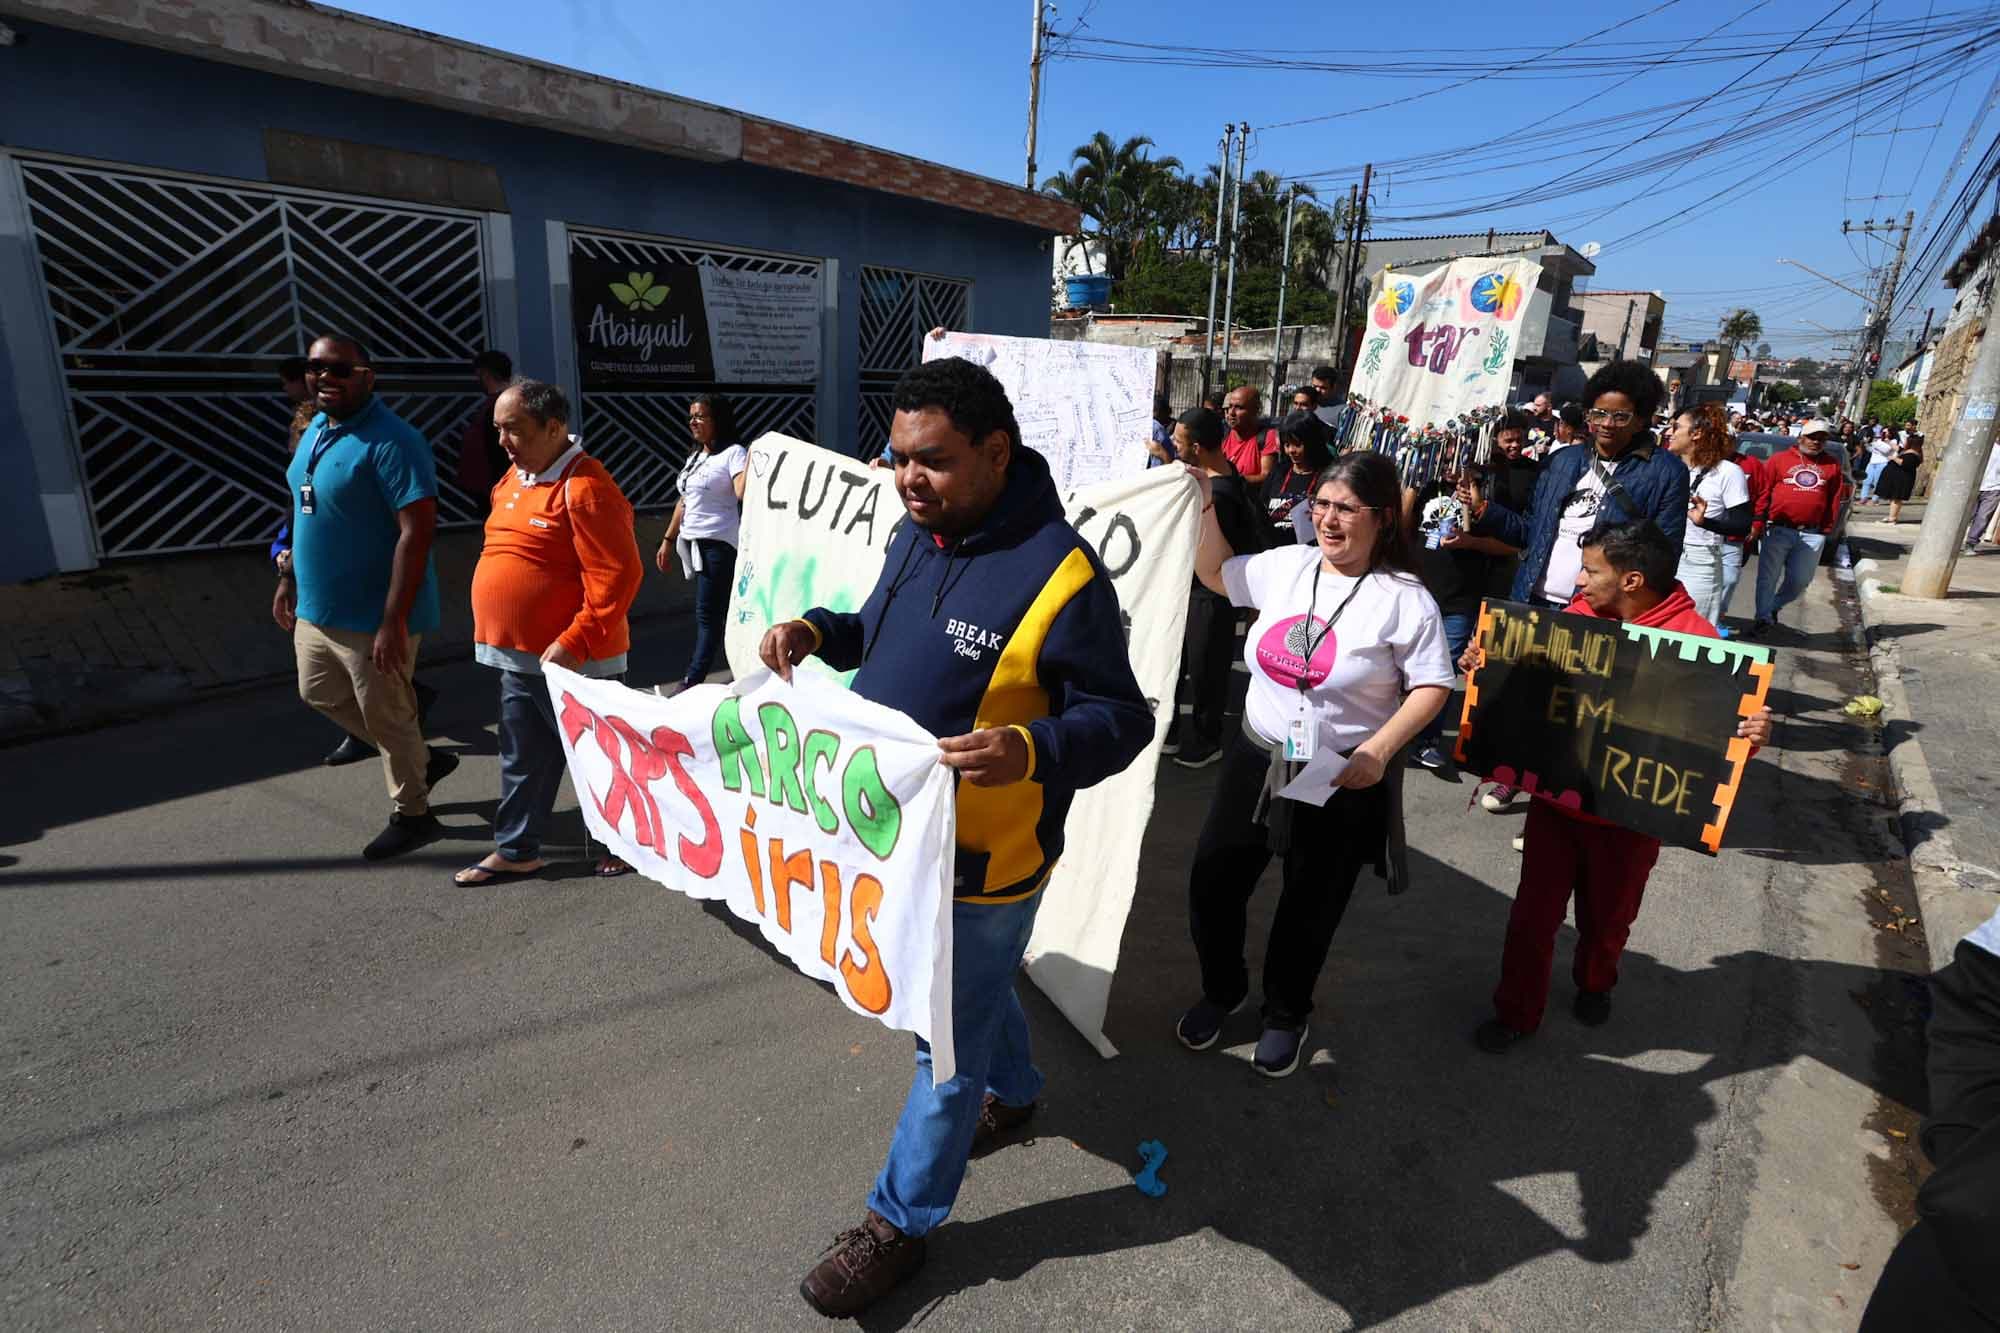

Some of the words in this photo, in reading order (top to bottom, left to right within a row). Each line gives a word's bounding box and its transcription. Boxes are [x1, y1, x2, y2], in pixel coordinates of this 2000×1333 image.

[588, 303, 694, 362] Abigail
[945, 618, 1003, 650] BREAK
[953, 639, 981, 661] Rules
[1549, 684, 1615, 734] EM
[711, 695, 902, 862] ARCO
[1601, 745, 1704, 816] REDE
